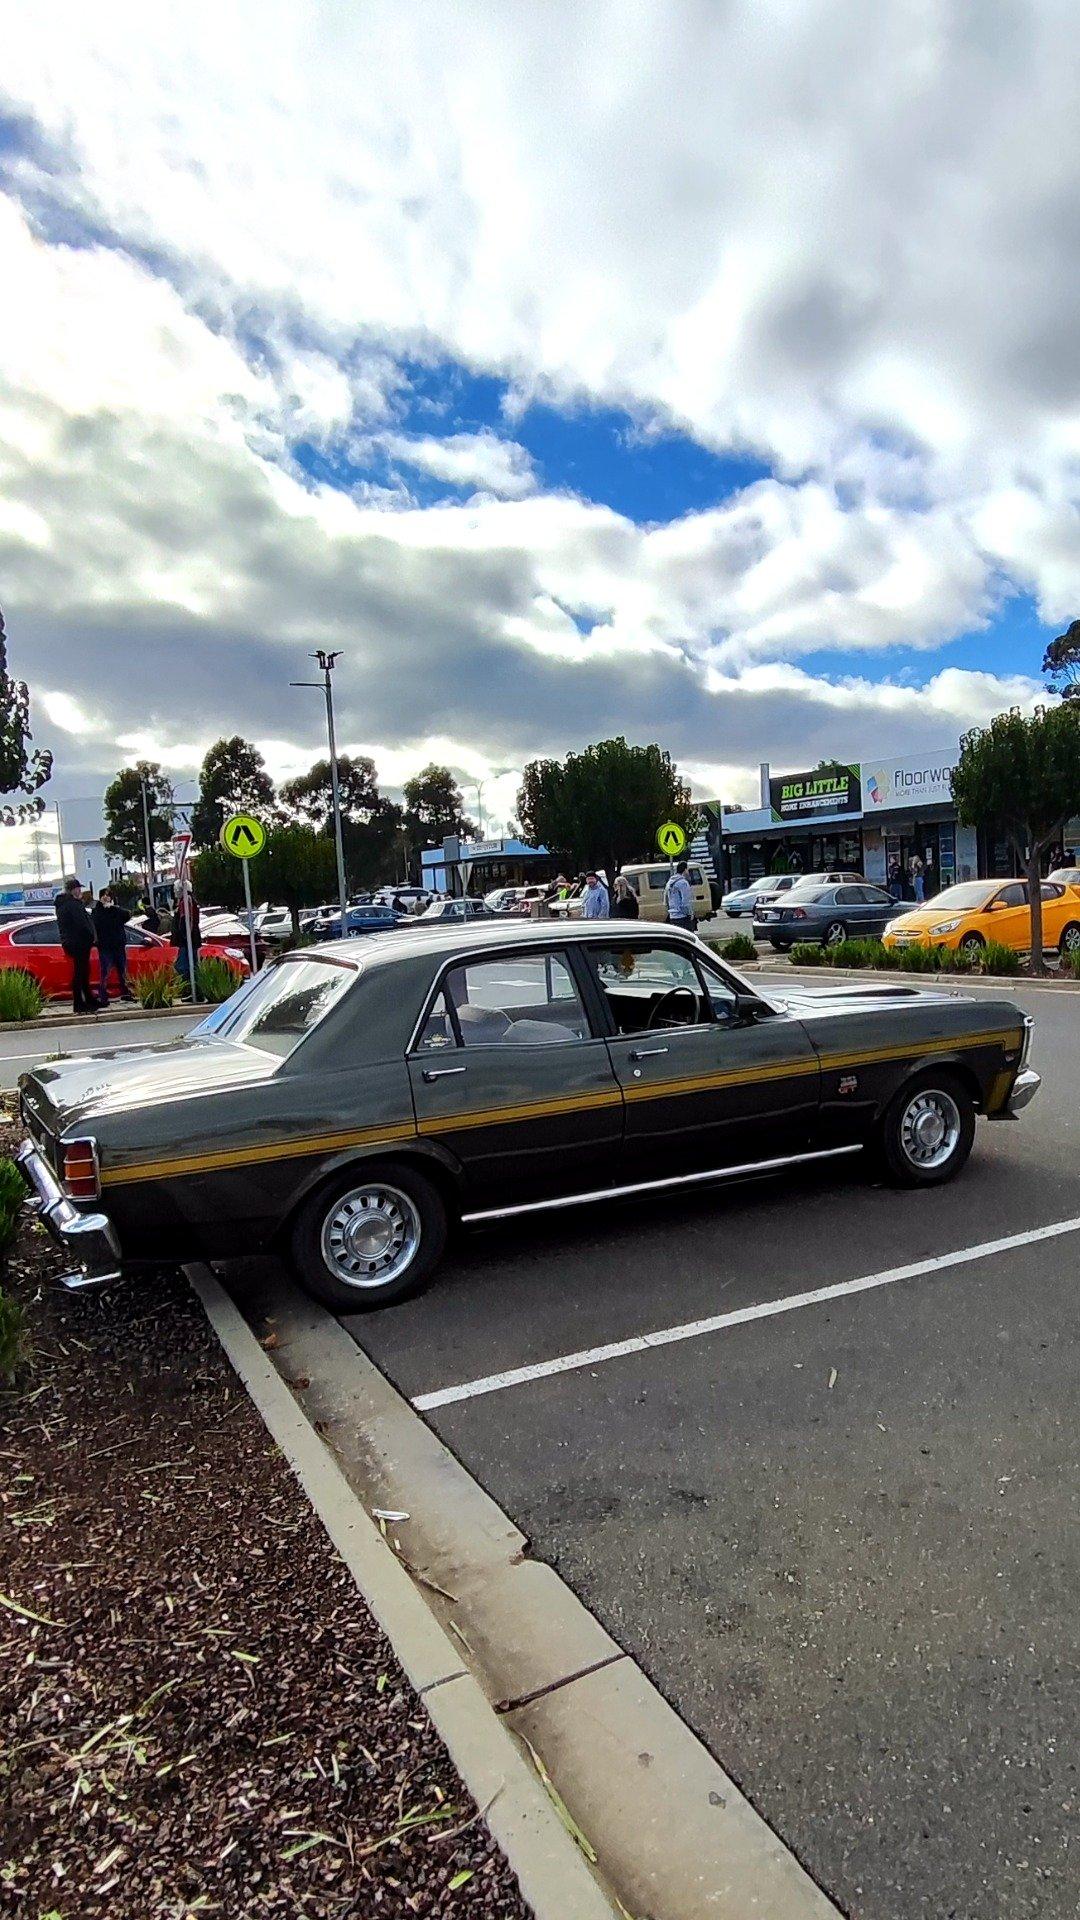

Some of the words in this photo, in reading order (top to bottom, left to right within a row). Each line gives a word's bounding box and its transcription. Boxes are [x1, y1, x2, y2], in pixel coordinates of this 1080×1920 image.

[781, 782, 804, 800] BIG
[805, 776, 849, 796] LITTLE
[895, 789, 910, 797] MORE
[912, 787, 927, 795] THAN
[780, 802, 798, 813] HOME
[798, 796, 849, 810] ENHANCEMENTS
